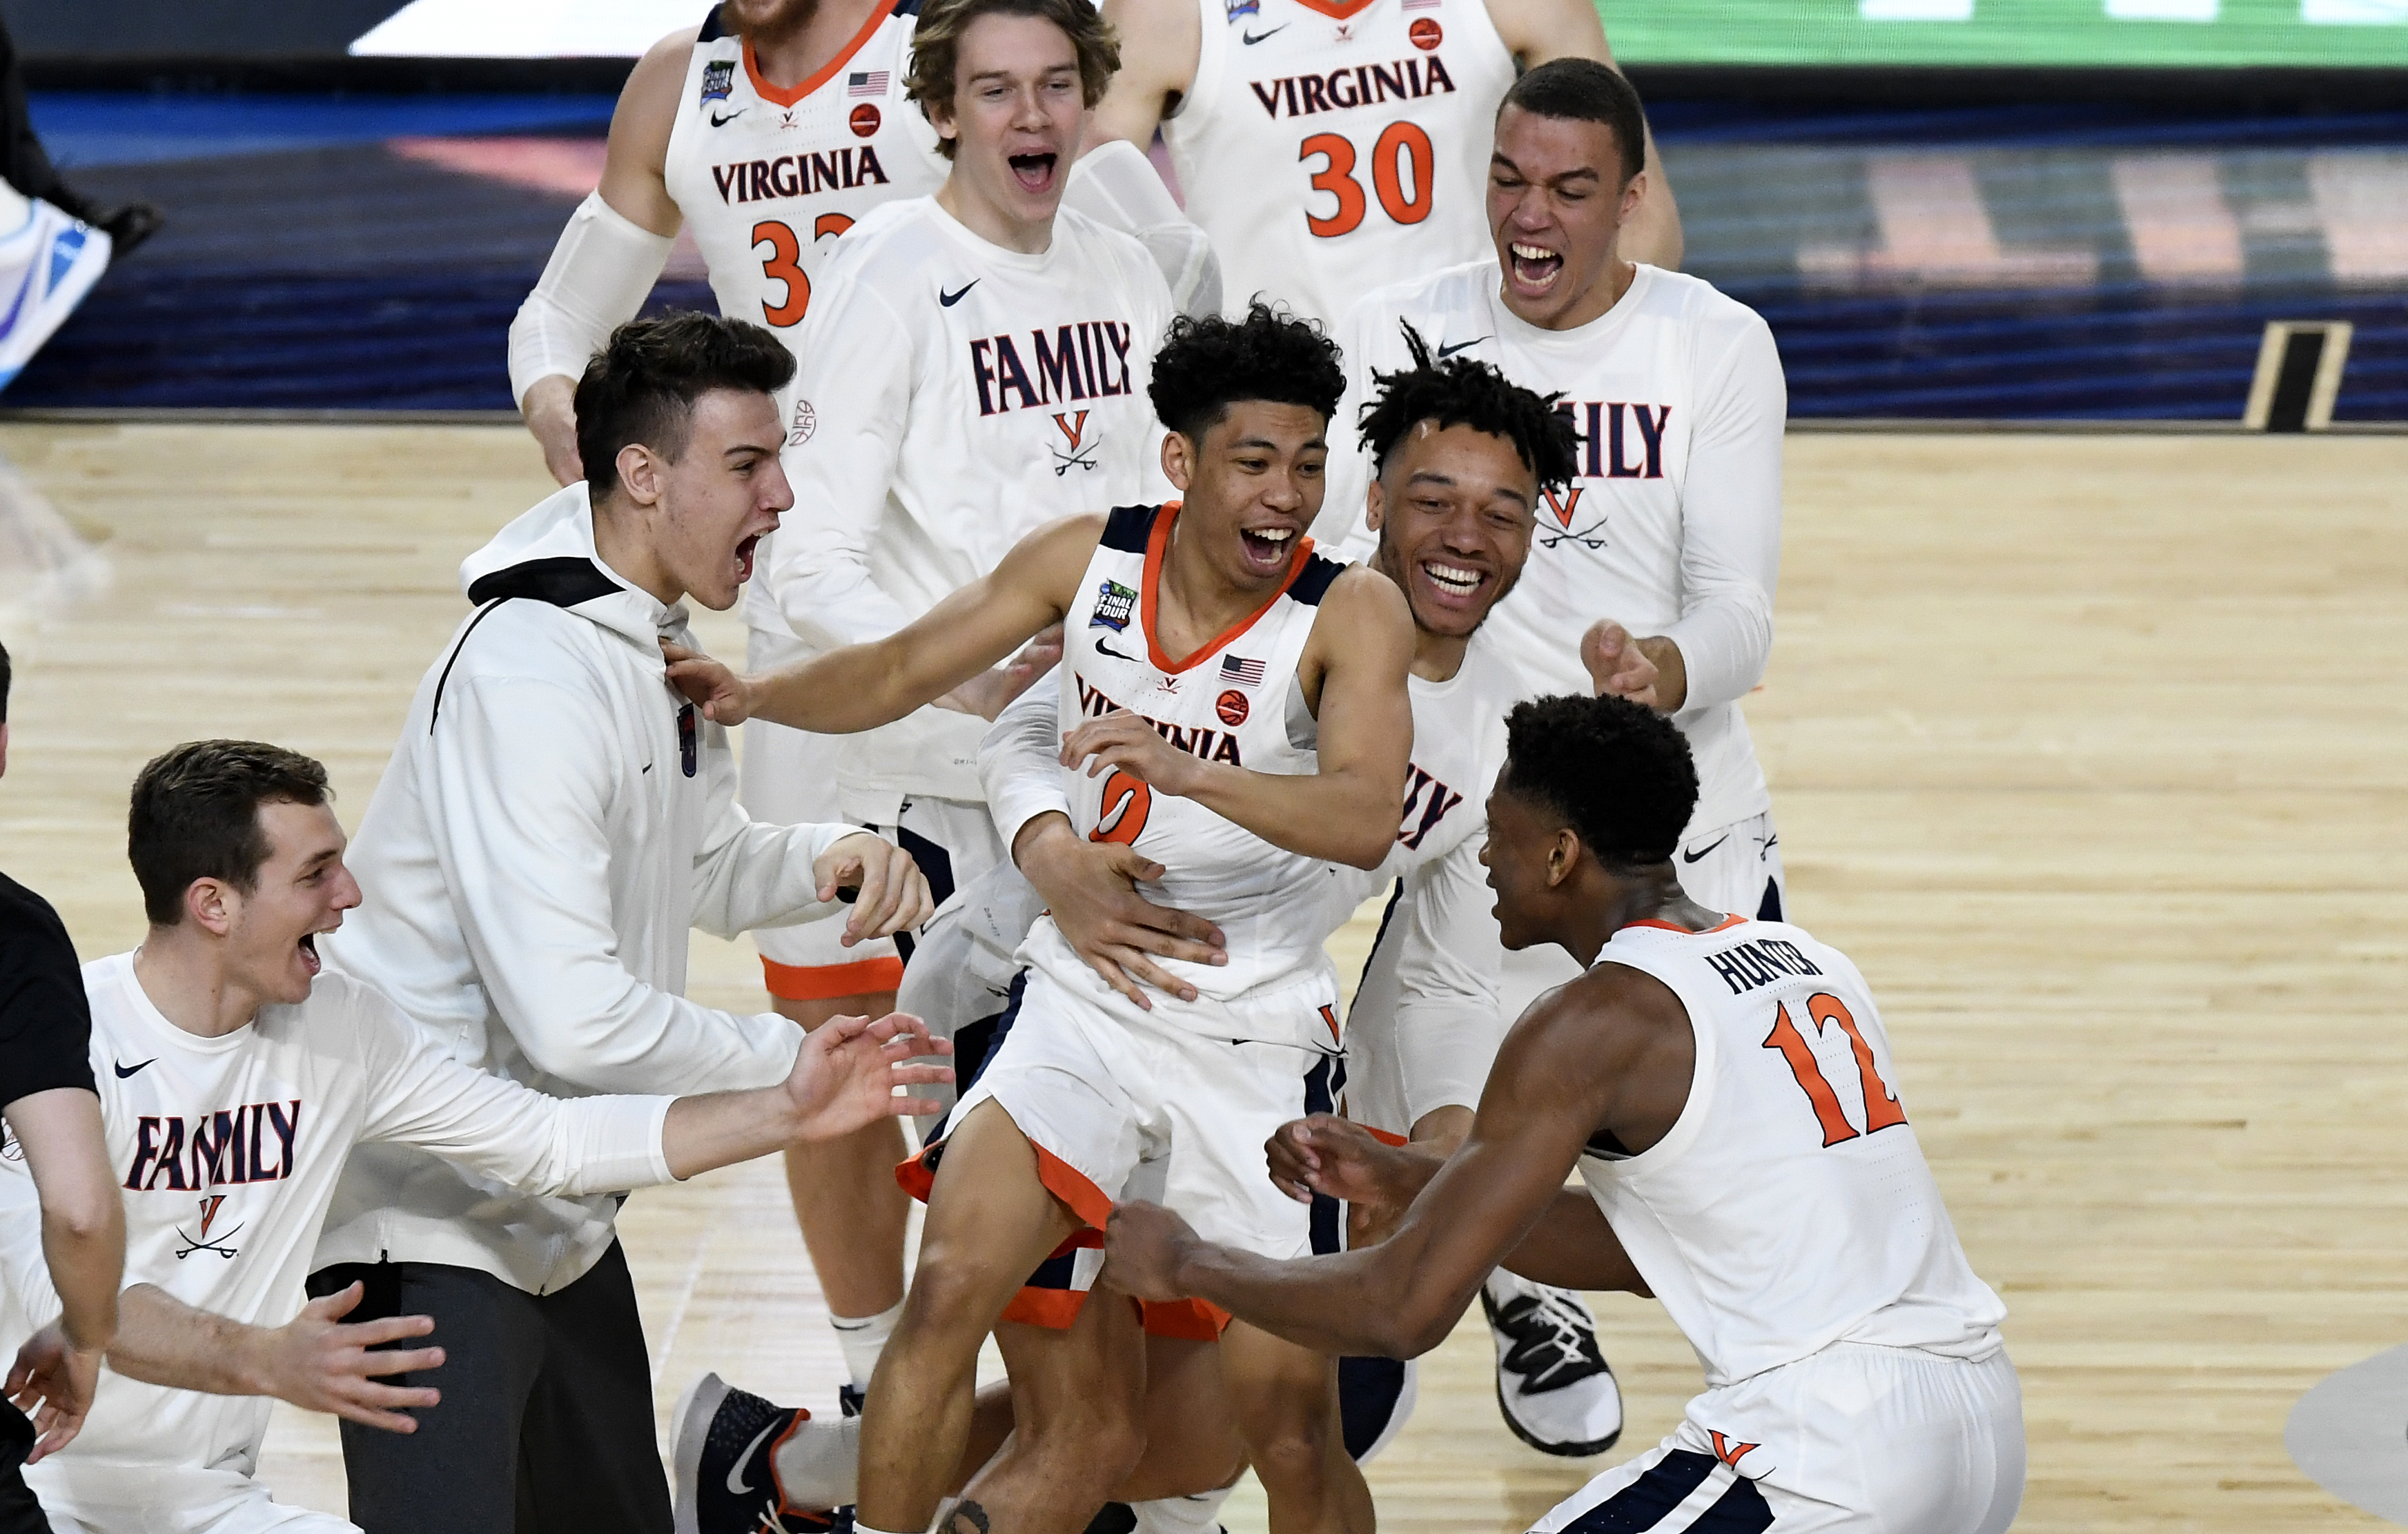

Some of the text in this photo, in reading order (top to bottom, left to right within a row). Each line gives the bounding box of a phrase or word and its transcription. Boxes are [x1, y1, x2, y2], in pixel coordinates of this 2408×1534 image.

[1250, 55, 1456, 119] VIRGINIA
[712, 145, 890, 206] VIRGINIA
[1299, 121, 1433, 238] 30
[970, 320, 1132, 417] FAMILY
[1096, 603, 1128, 620] FOUR
[1100, 594, 1132, 609] FINAL
[1703, 938, 1824, 995] HUNTER
[1761, 992, 1910, 1148] 12
[122, 1099, 302, 1191] FAMILY
